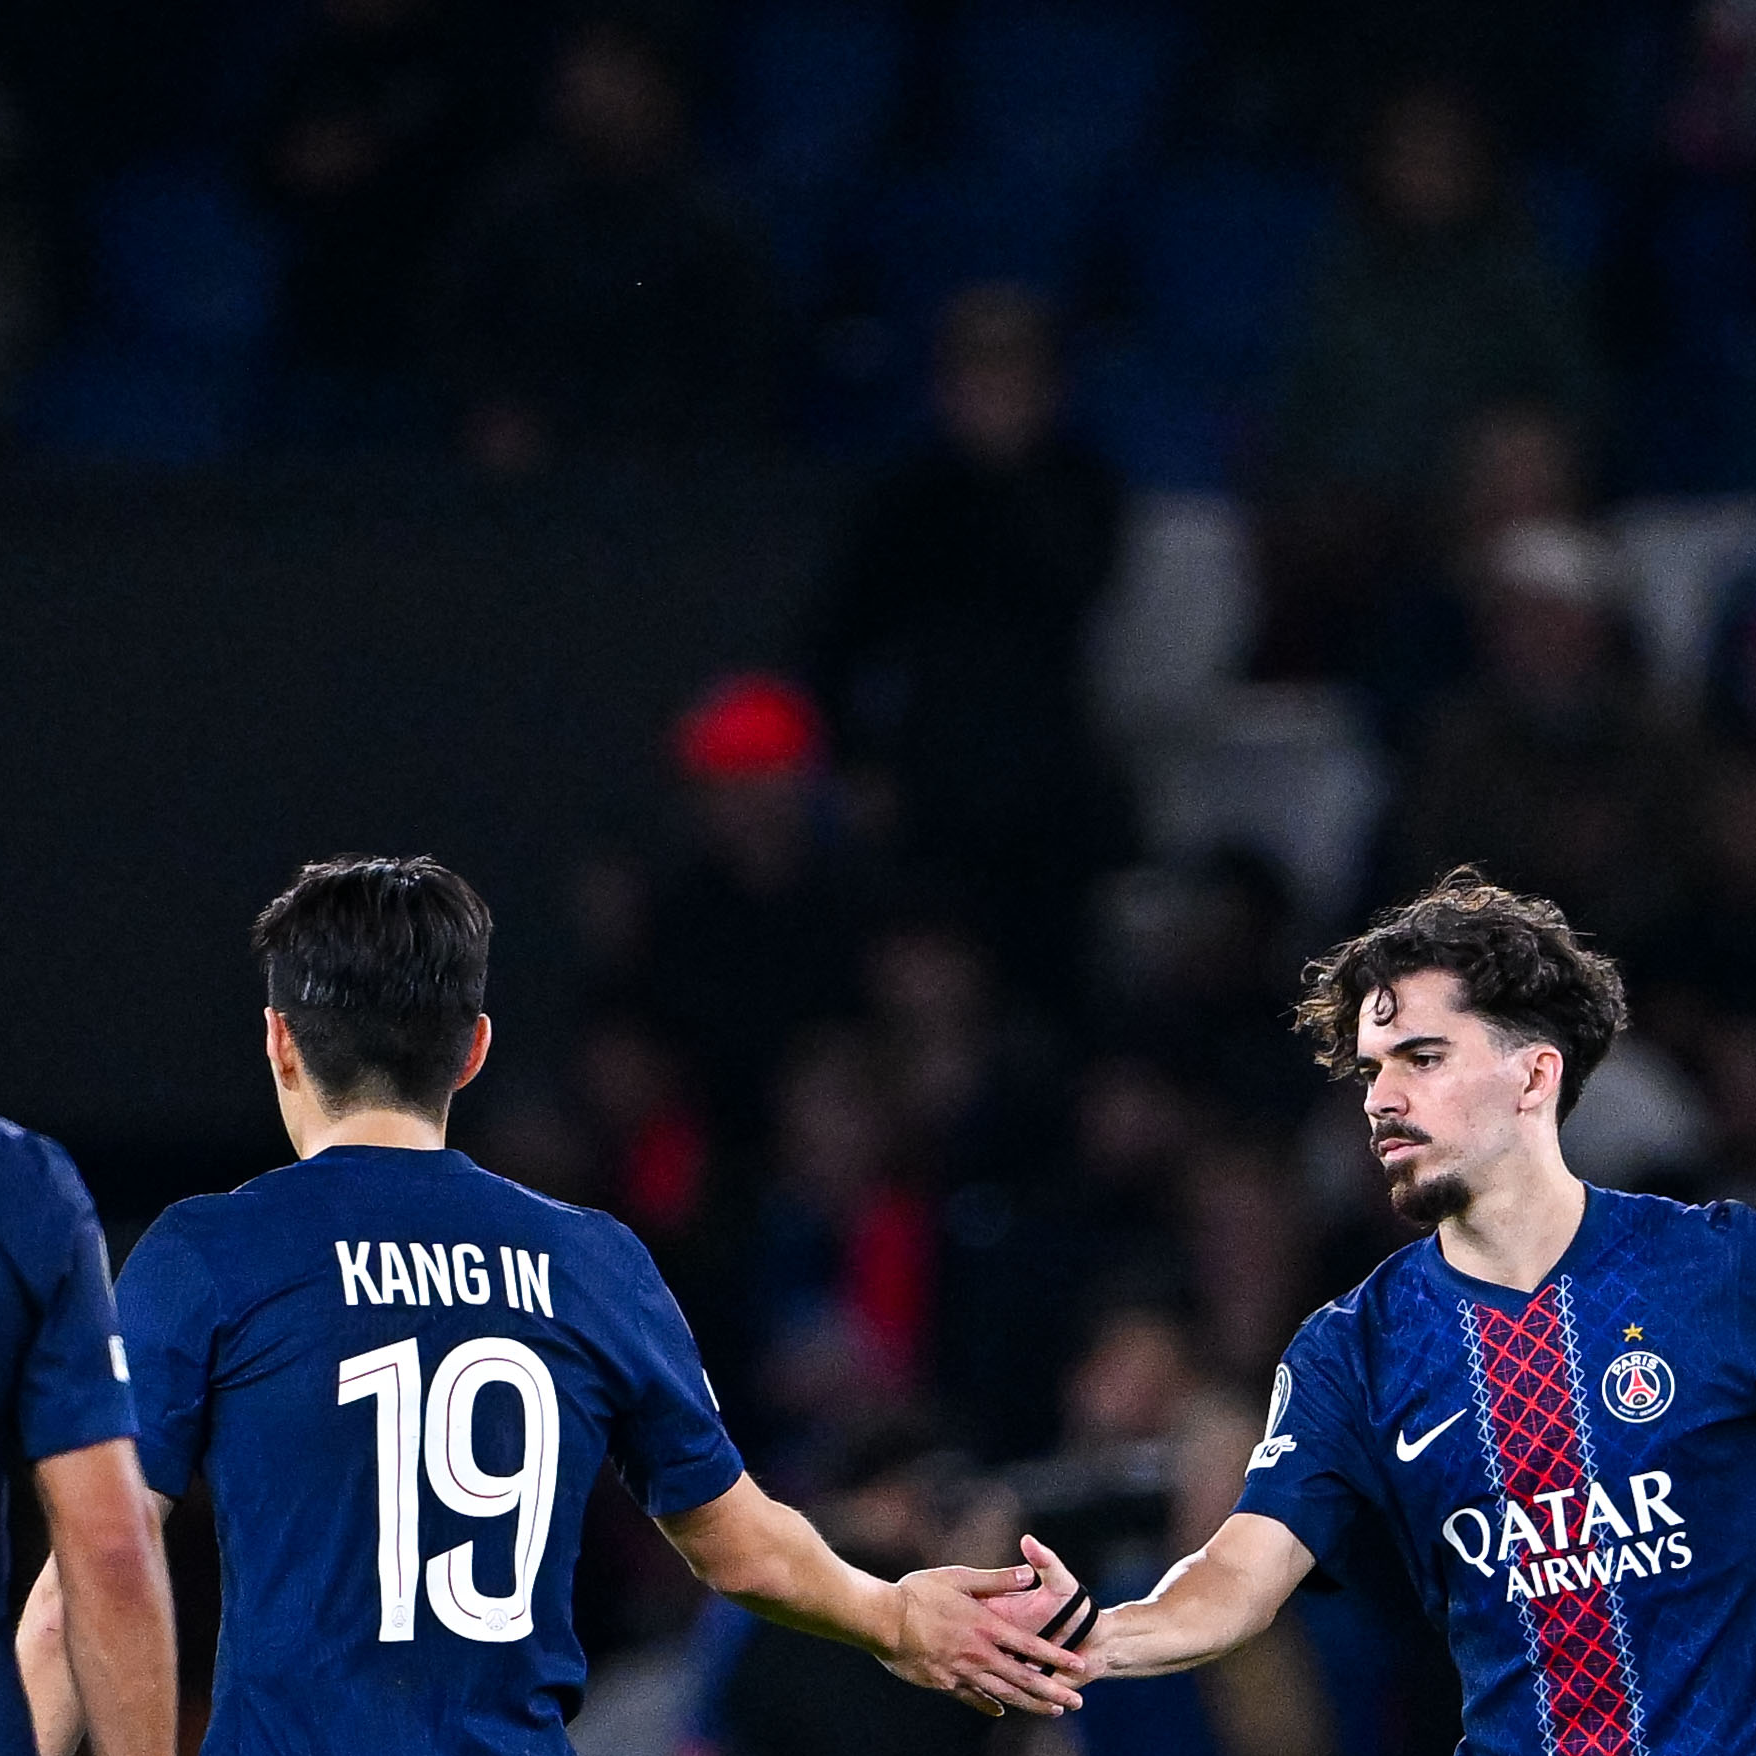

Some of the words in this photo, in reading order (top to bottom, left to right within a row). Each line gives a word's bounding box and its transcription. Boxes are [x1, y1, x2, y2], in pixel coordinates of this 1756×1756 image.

[335, 1240, 491, 1306] KANG
[500, 1245, 554, 1318] IN
[1611, 1355, 1659, 1376] PARIS
[338, 1336, 560, 1643] 19
[1442, 1470, 1686, 1578] QATAR
[1506, 1531, 1693, 1602] AIRWAYS
